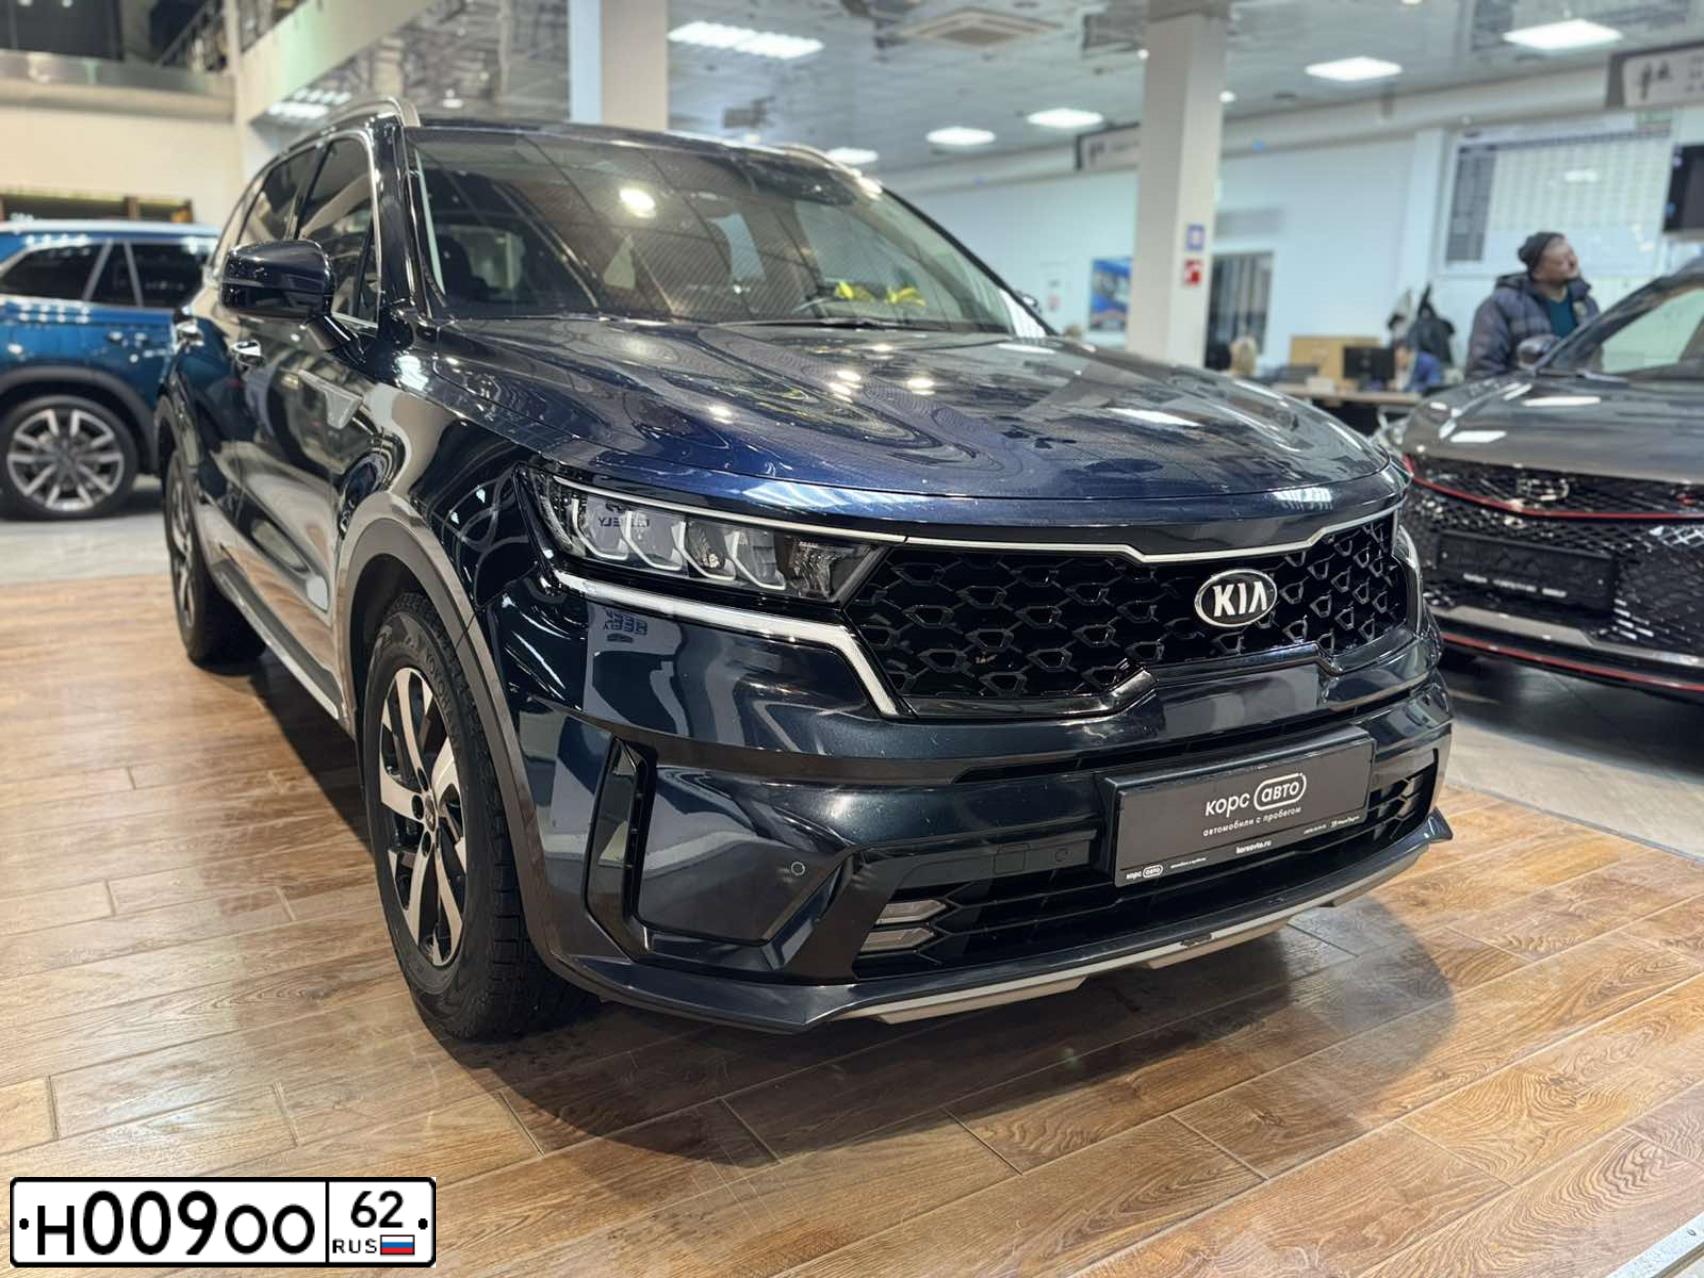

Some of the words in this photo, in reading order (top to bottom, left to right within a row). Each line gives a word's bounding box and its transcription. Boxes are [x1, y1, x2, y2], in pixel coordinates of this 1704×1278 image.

[1212, 580, 1268, 617] KIA
[1205, 793, 1251, 818] корс
[1260, 780, 1300, 803] авто
